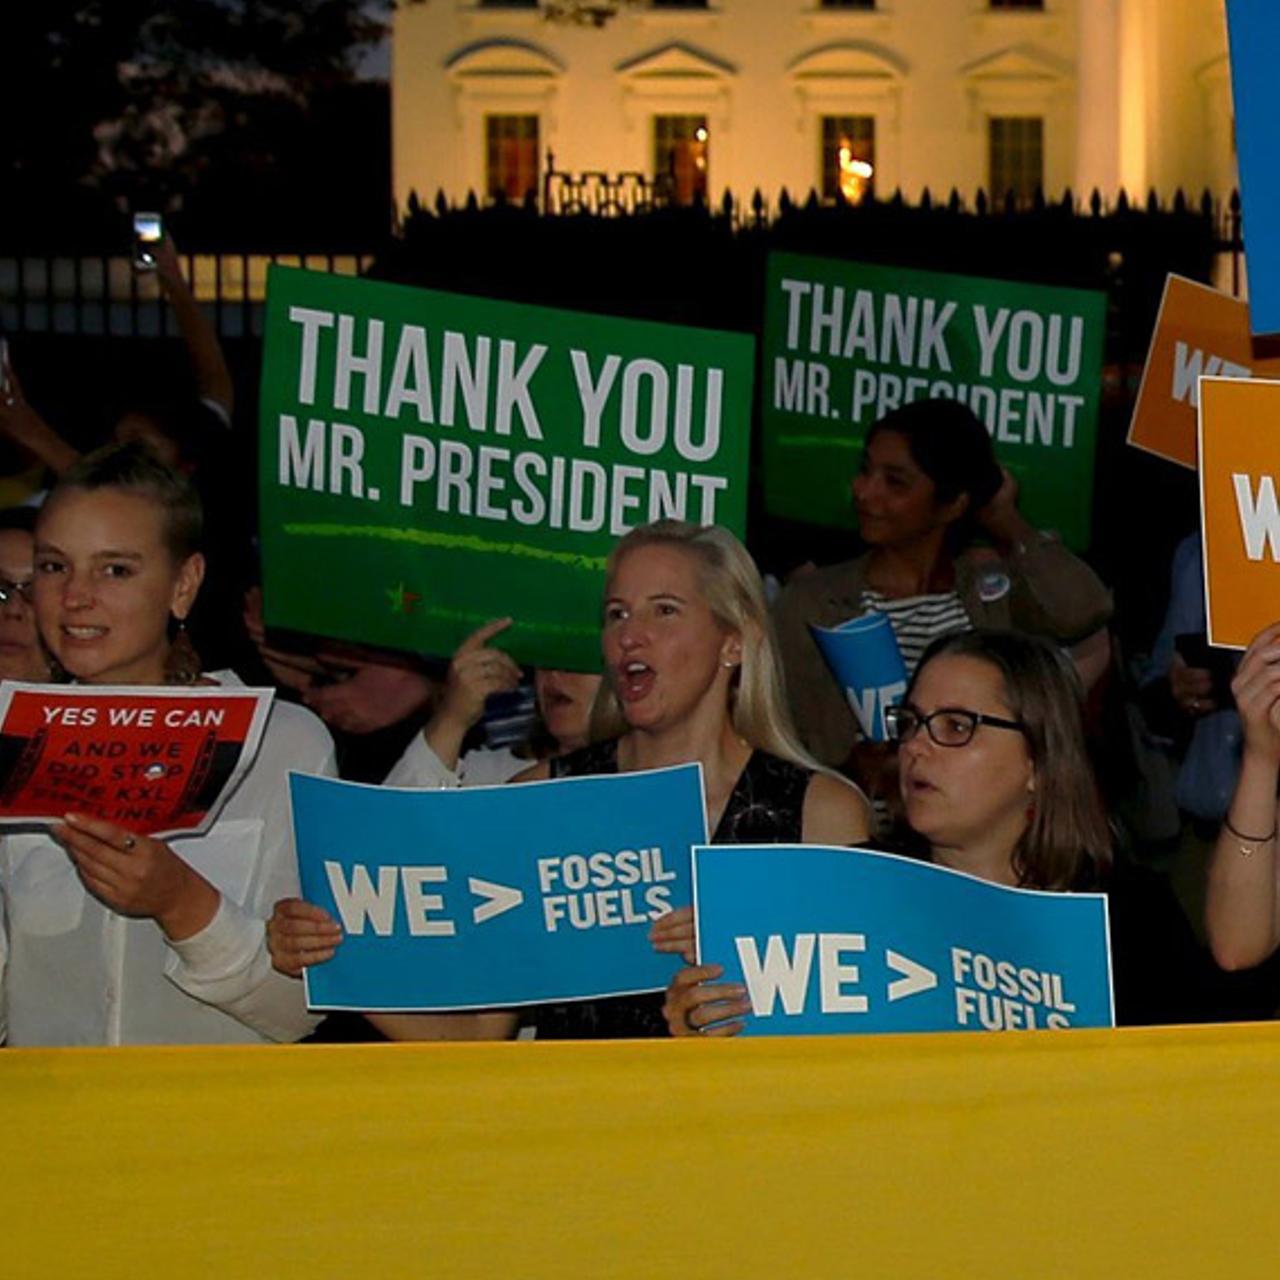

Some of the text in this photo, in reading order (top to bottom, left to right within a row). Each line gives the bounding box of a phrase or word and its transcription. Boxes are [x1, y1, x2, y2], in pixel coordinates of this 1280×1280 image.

[780, 277, 1085, 387] THANK YOU
[288, 305, 726, 464] THANK YOU
[773, 356, 840, 420] MR.
[1171, 340, 1253, 408] W
[278, 414, 731, 538] MR. PRESIDENT
[42, 706, 226, 728] YES WE CAN
[63, 740, 185, 759] AND WE
[46, 761, 100, 780] DID
[323, 860, 457, 937] WE
[536, 846, 677, 893] FOSSIL
[542, 885, 675, 933] FUELS
[734, 932, 870, 1018] WE
[950, 946, 1078, 1014] FOSSIL
